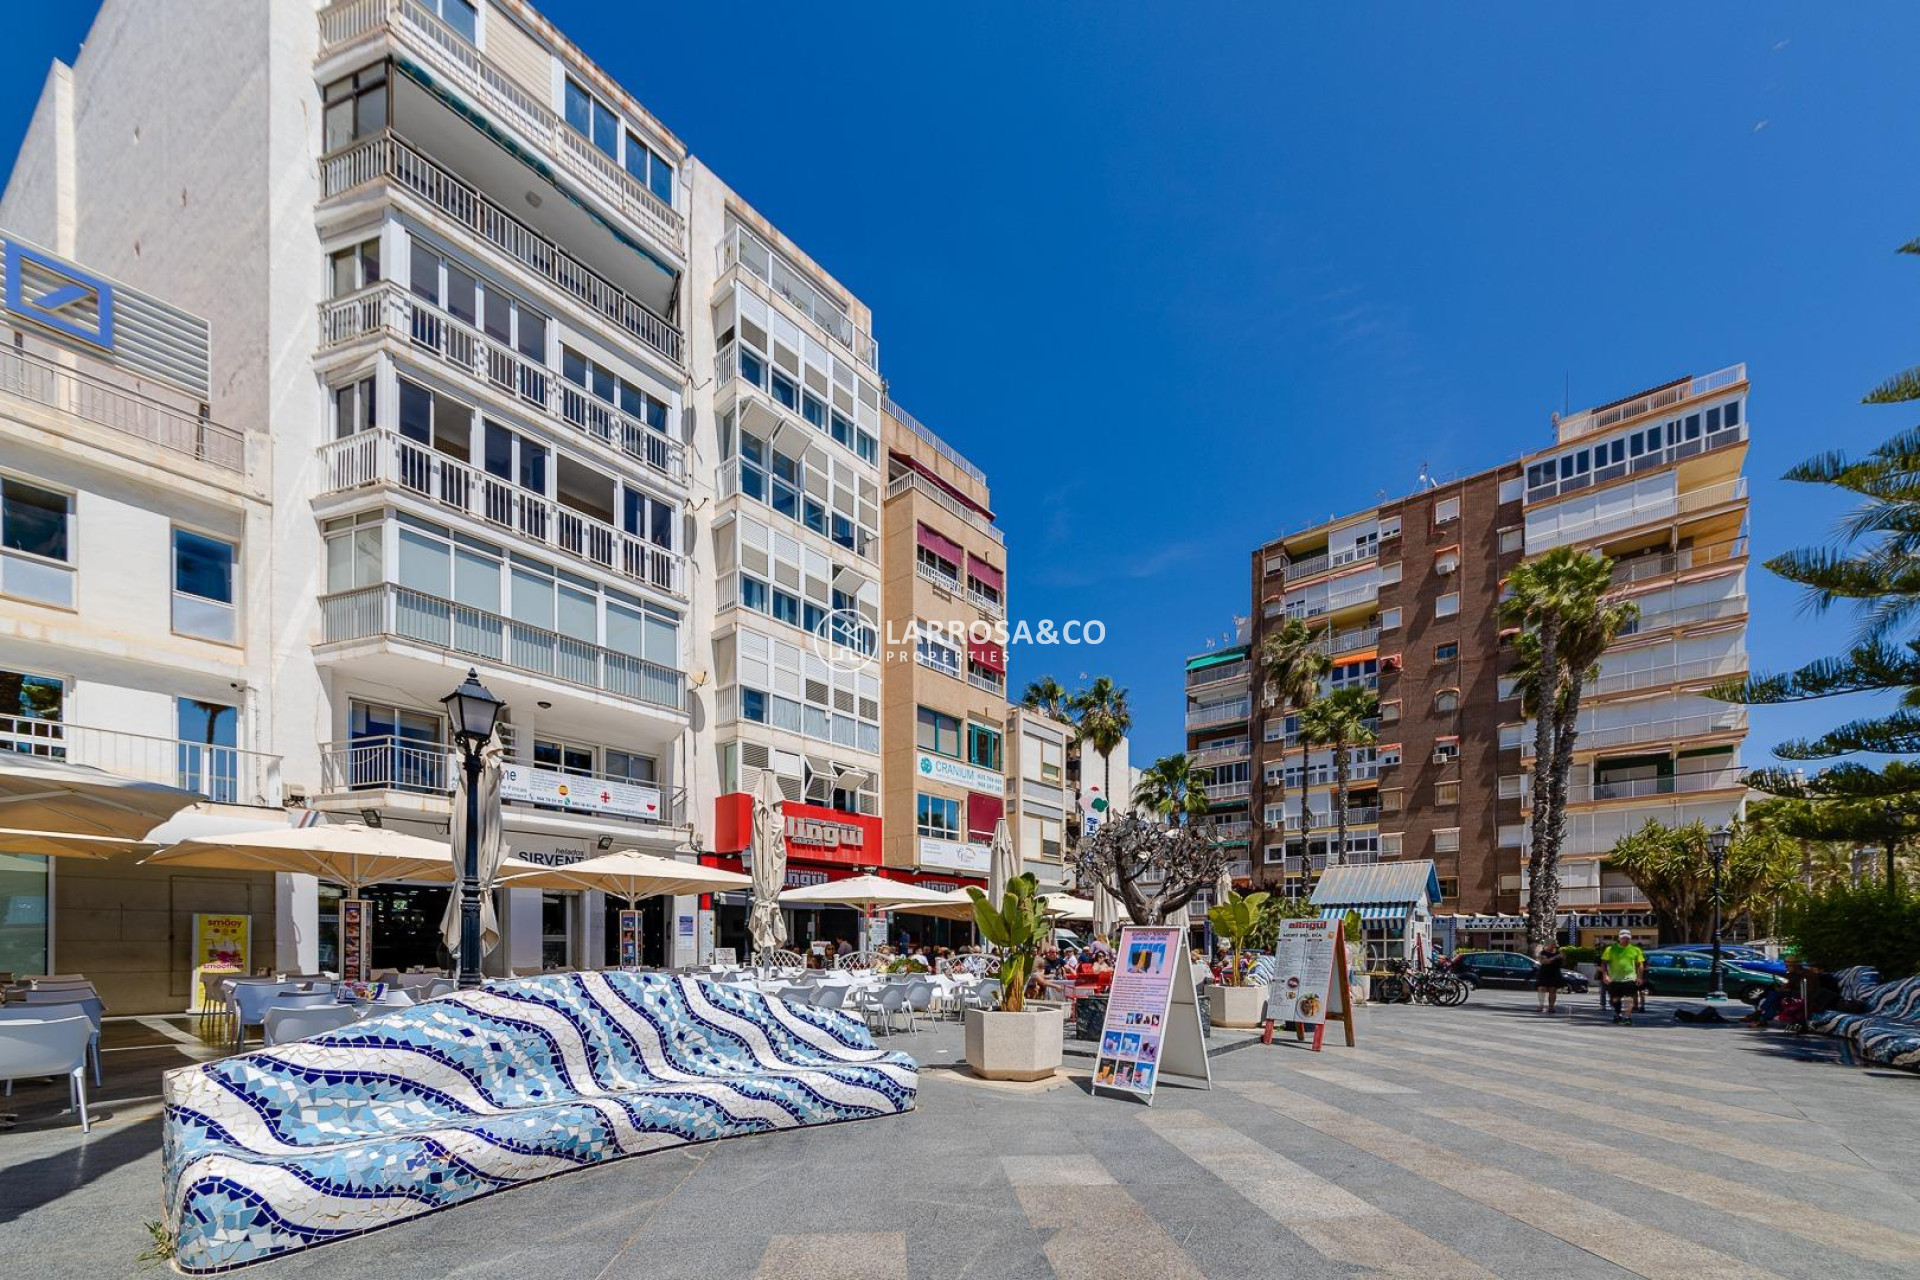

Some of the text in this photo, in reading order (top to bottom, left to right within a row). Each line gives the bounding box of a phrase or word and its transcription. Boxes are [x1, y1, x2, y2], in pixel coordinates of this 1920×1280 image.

[935, 760, 975, 781] CRANIUM
[786, 816, 864, 848] lingui
[518, 851, 585, 866] SIRVENT
[555, 847, 584, 856] helados
[1579, 914, 1659, 928] CENTRO
